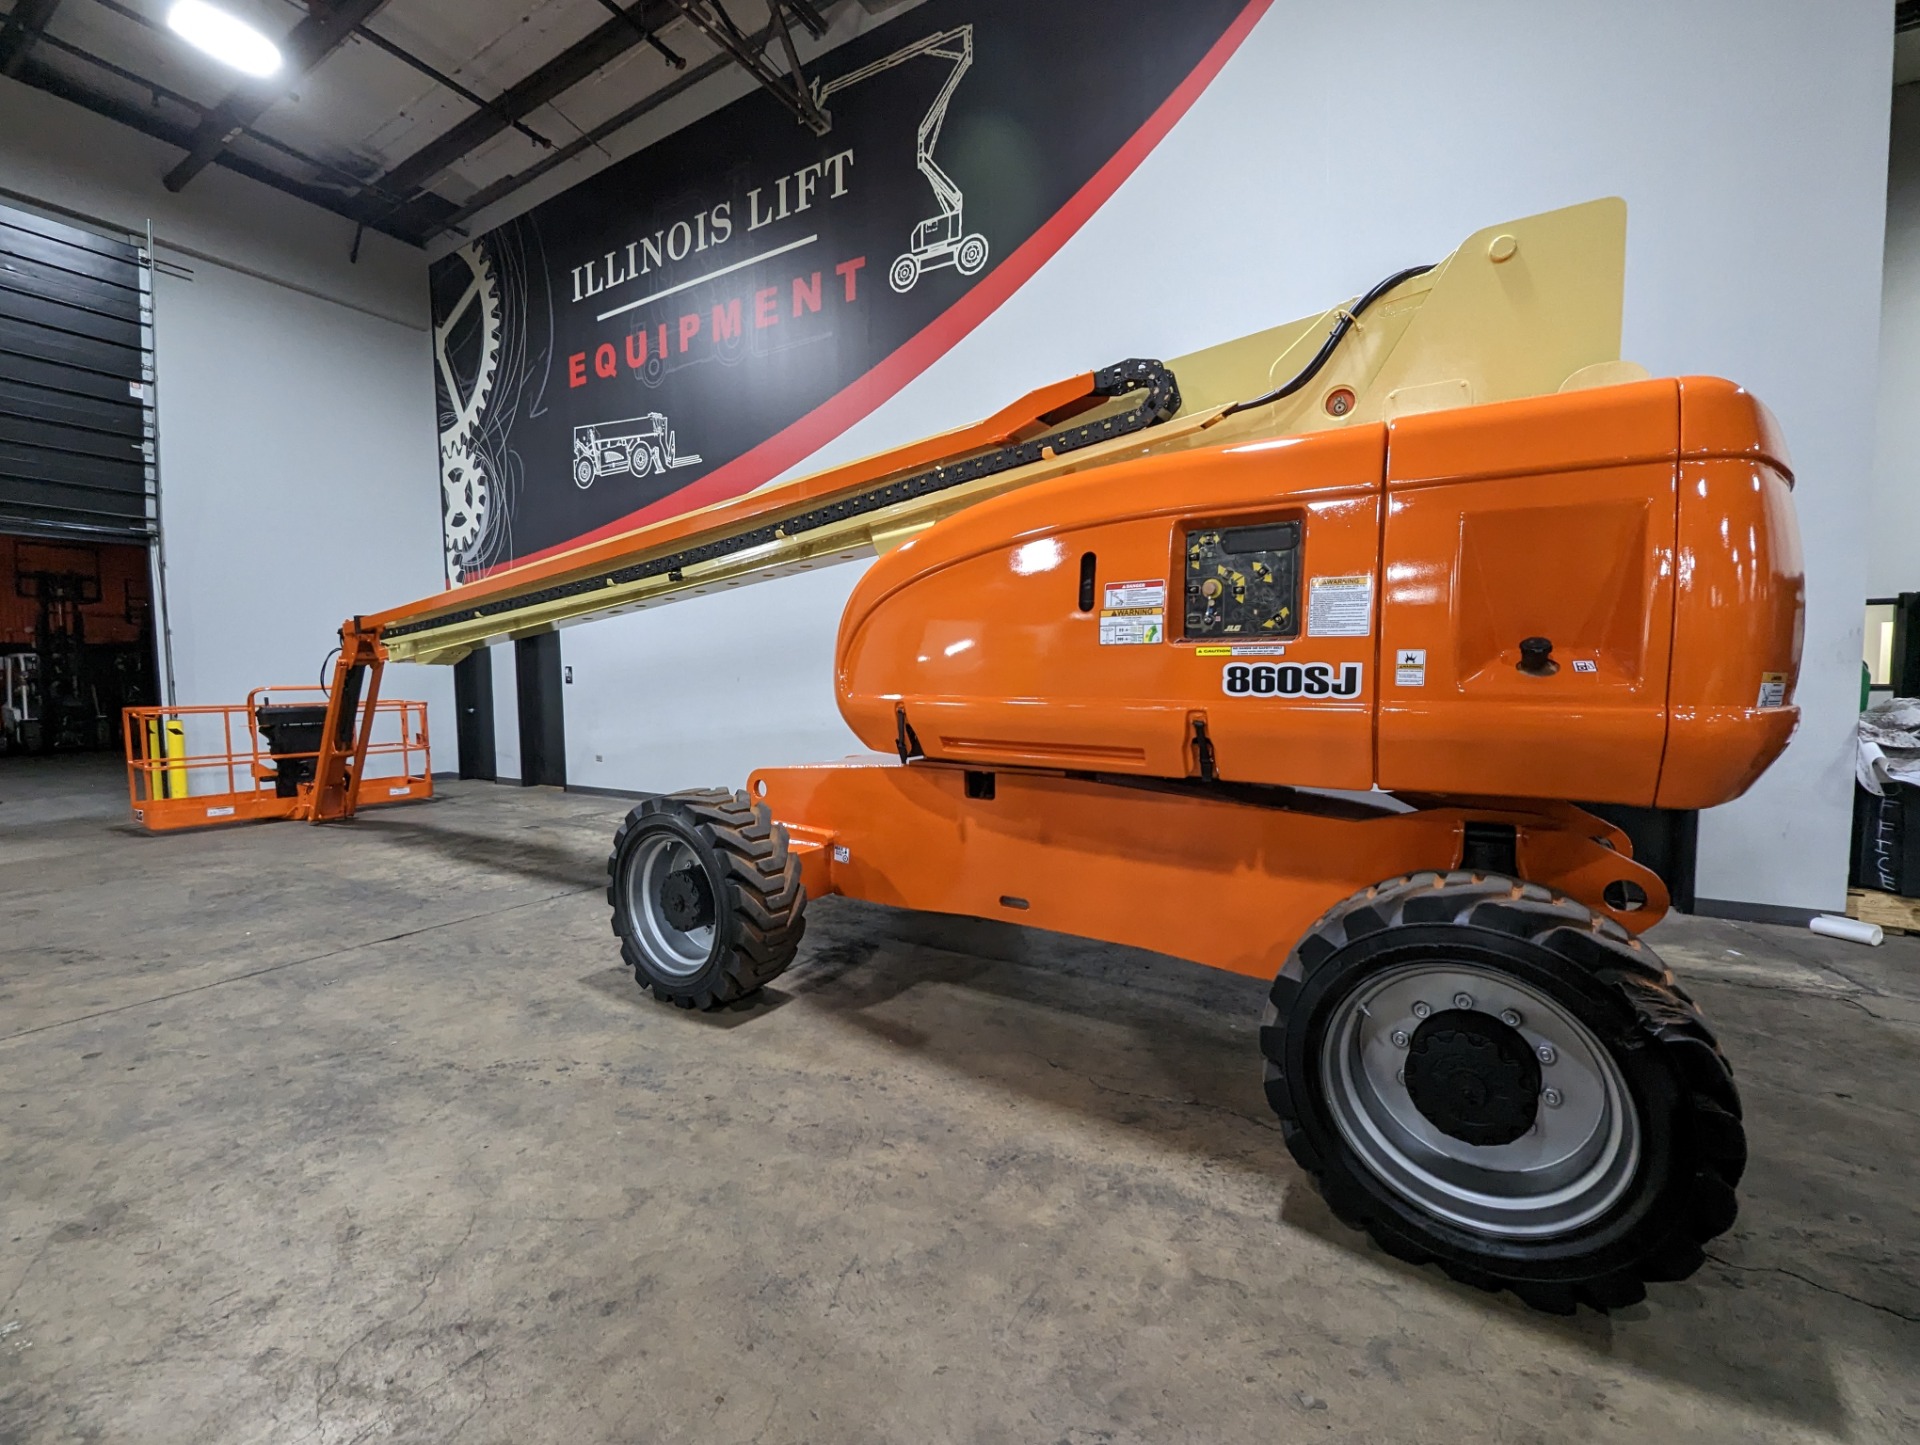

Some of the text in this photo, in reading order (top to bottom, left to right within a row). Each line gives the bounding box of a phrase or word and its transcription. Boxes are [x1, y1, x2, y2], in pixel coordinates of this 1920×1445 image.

[571, 149, 853, 303] ILLINOIS LIFT
[568, 256, 866, 389] EQUIPMENT
[1117, 608, 1154, 616] WARNING
[1225, 664, 1360, 697] 860SJ
